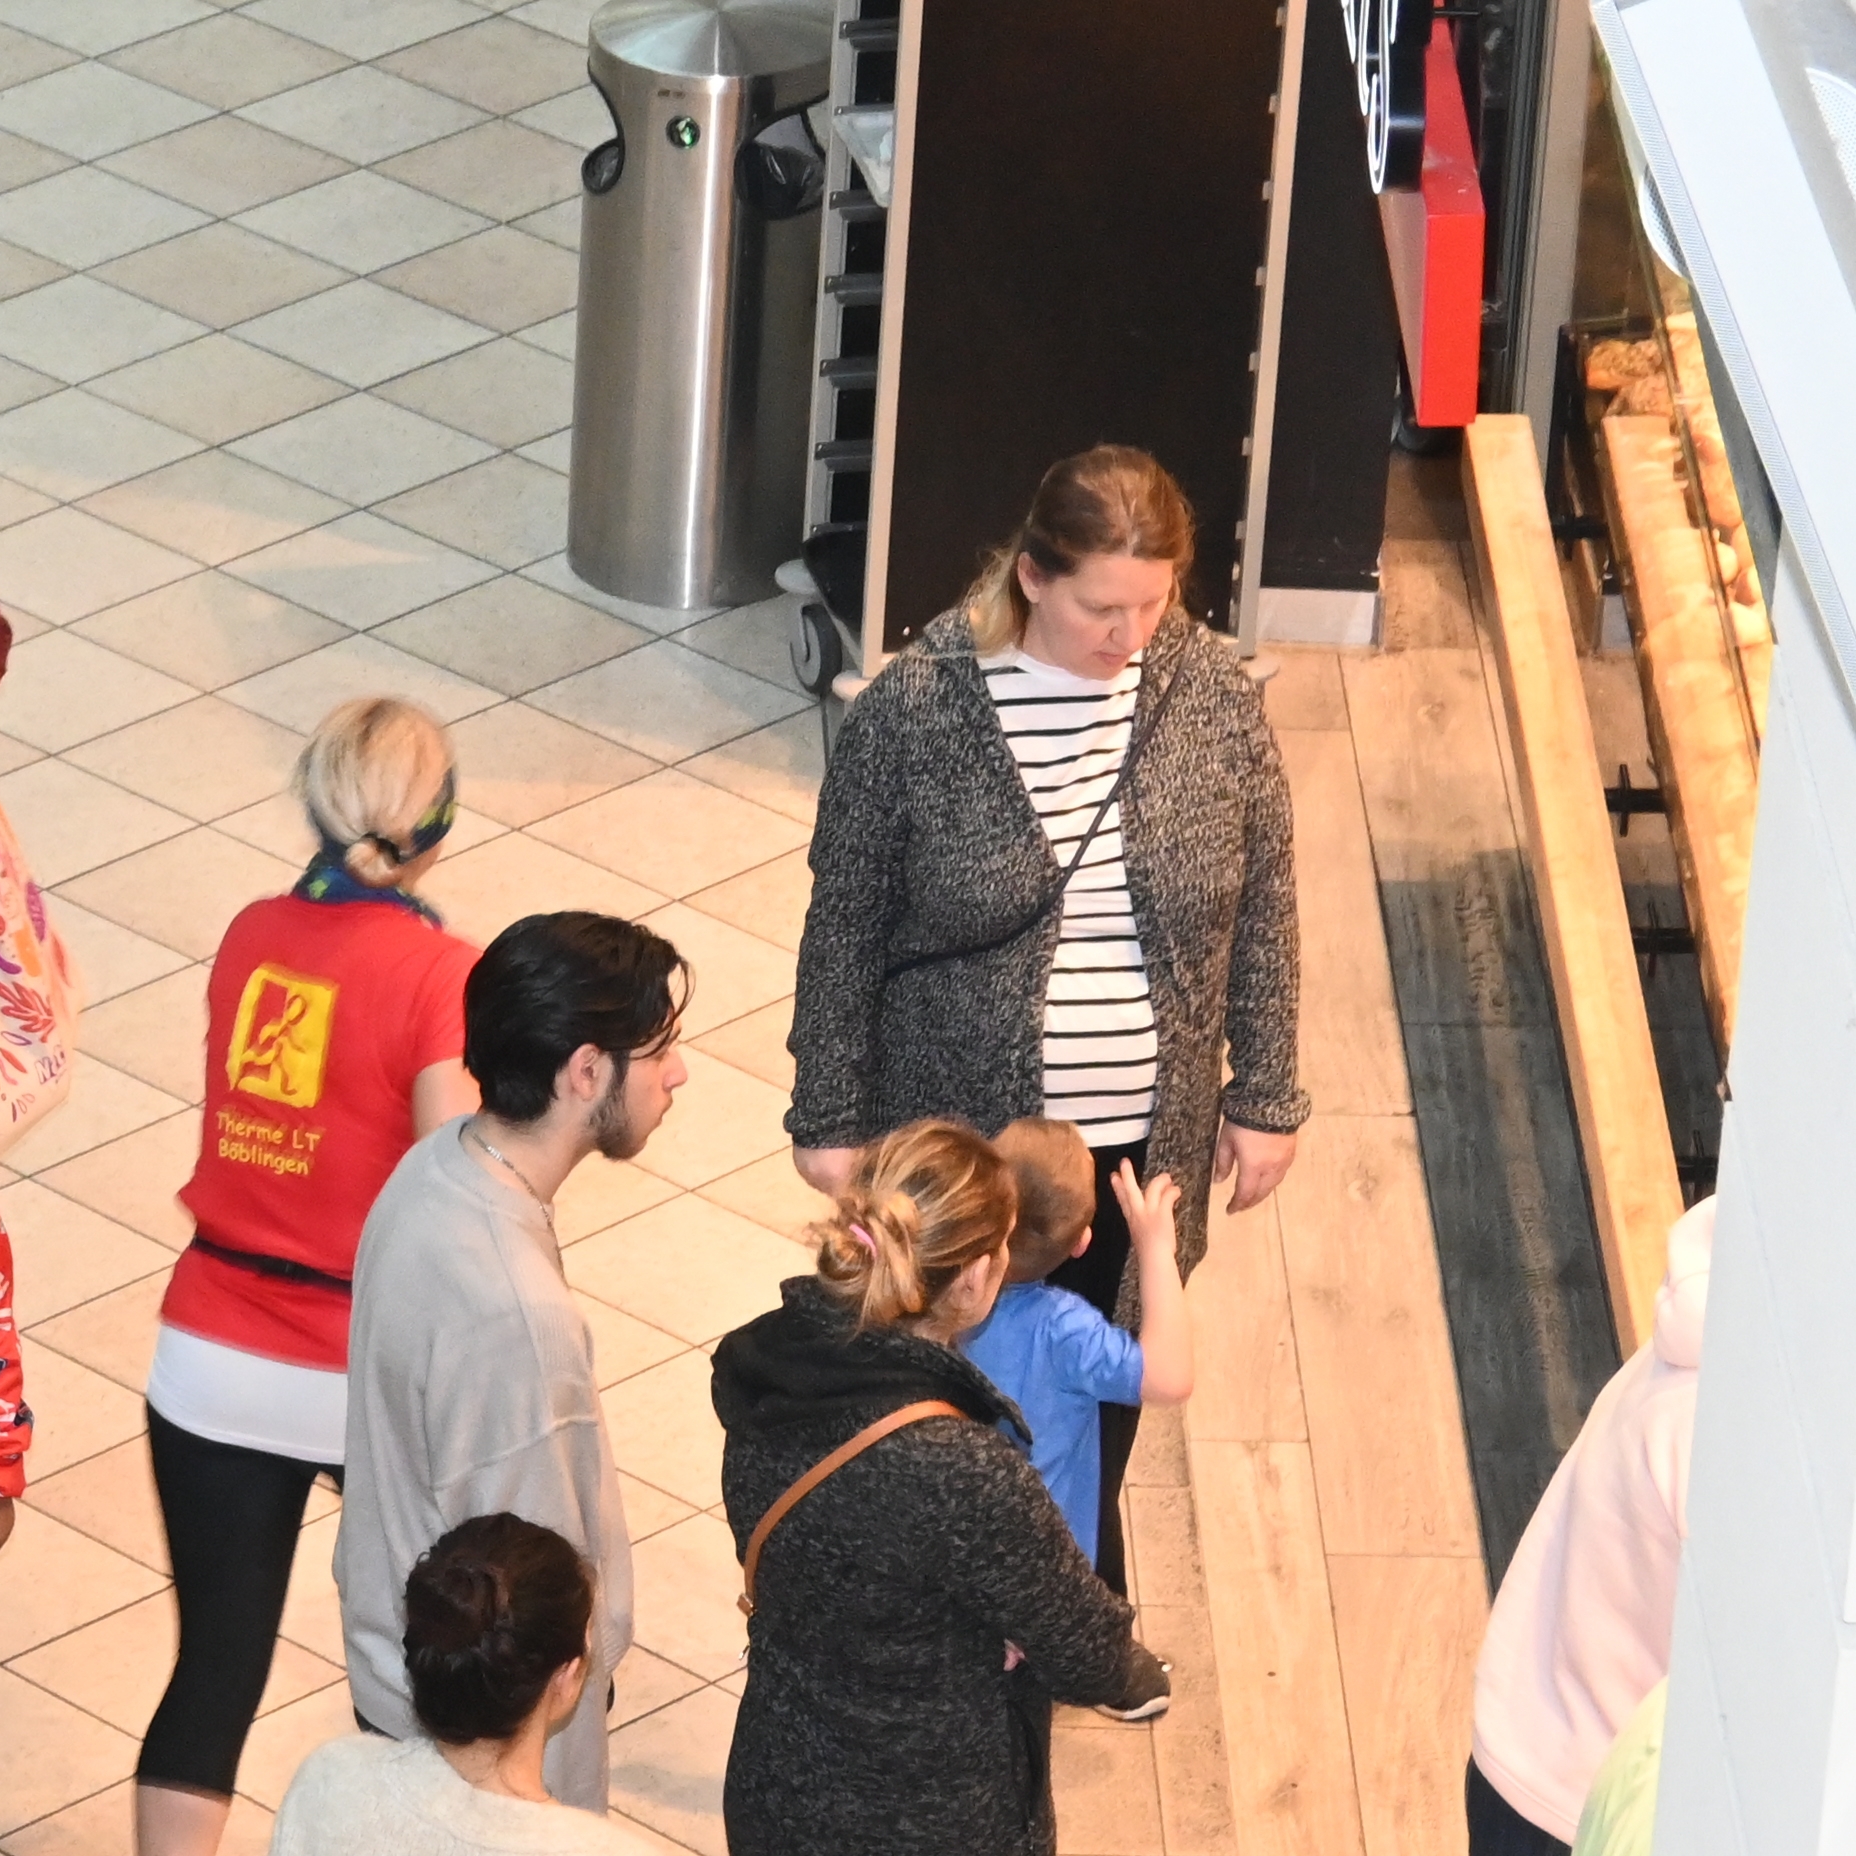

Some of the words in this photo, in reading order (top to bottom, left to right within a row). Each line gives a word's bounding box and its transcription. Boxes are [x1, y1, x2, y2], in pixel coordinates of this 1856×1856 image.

[218, 1112, 284, 1144] Therme
[292, 1130, 320, 1151] LT
[218, 1138, 308, 1175] Böblingen
